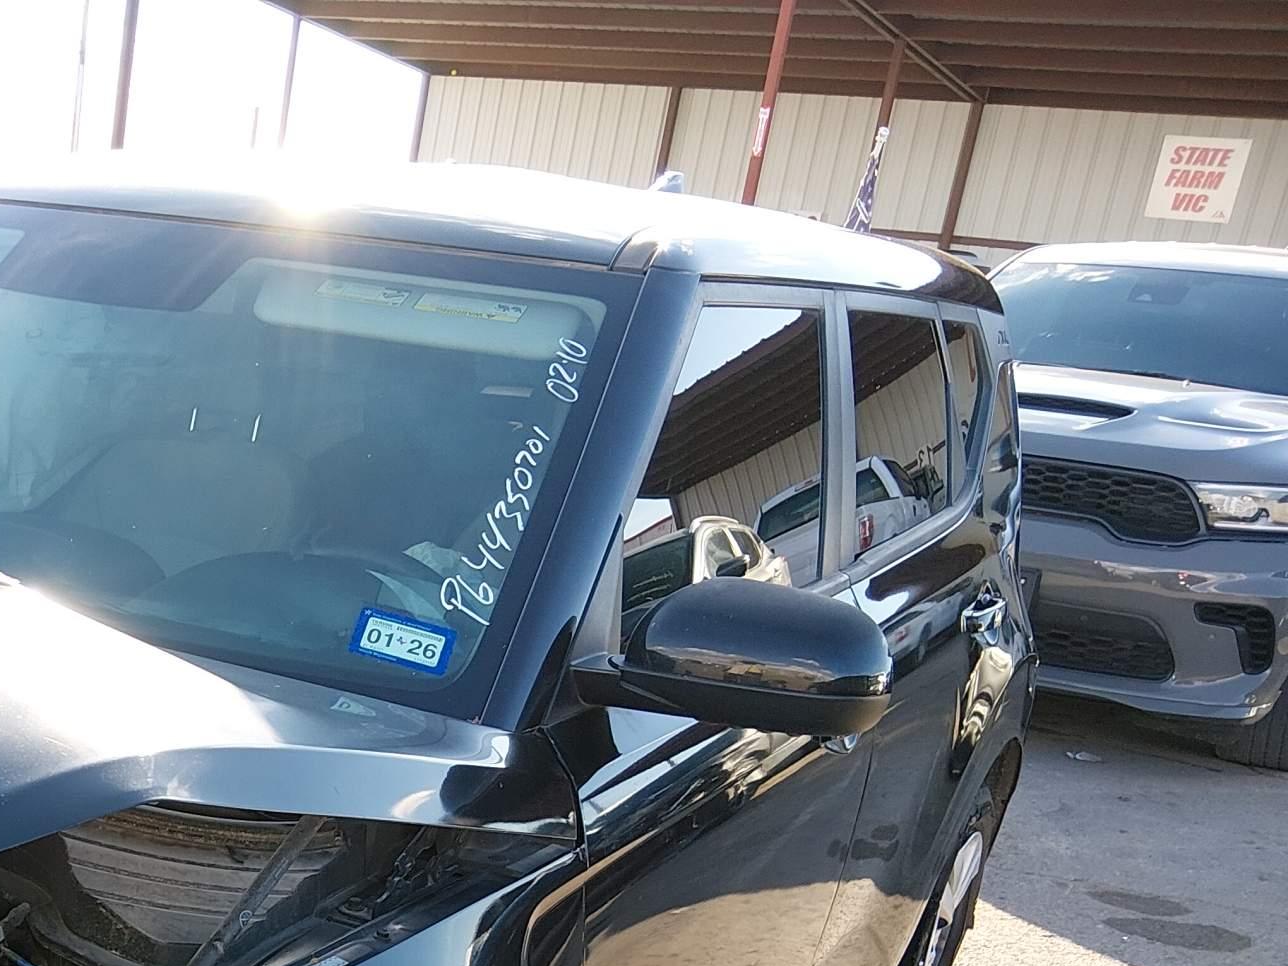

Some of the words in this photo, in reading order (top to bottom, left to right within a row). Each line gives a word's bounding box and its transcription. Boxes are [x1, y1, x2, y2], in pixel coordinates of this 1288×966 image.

[1169, 146, 1235, 168] STATE
[1164, 169, 1227, 190] FARM
[1170, 193, 1209, 213] VIC
[367, 628, 394, 648] 01
[406, 639, 438, 660] 26
